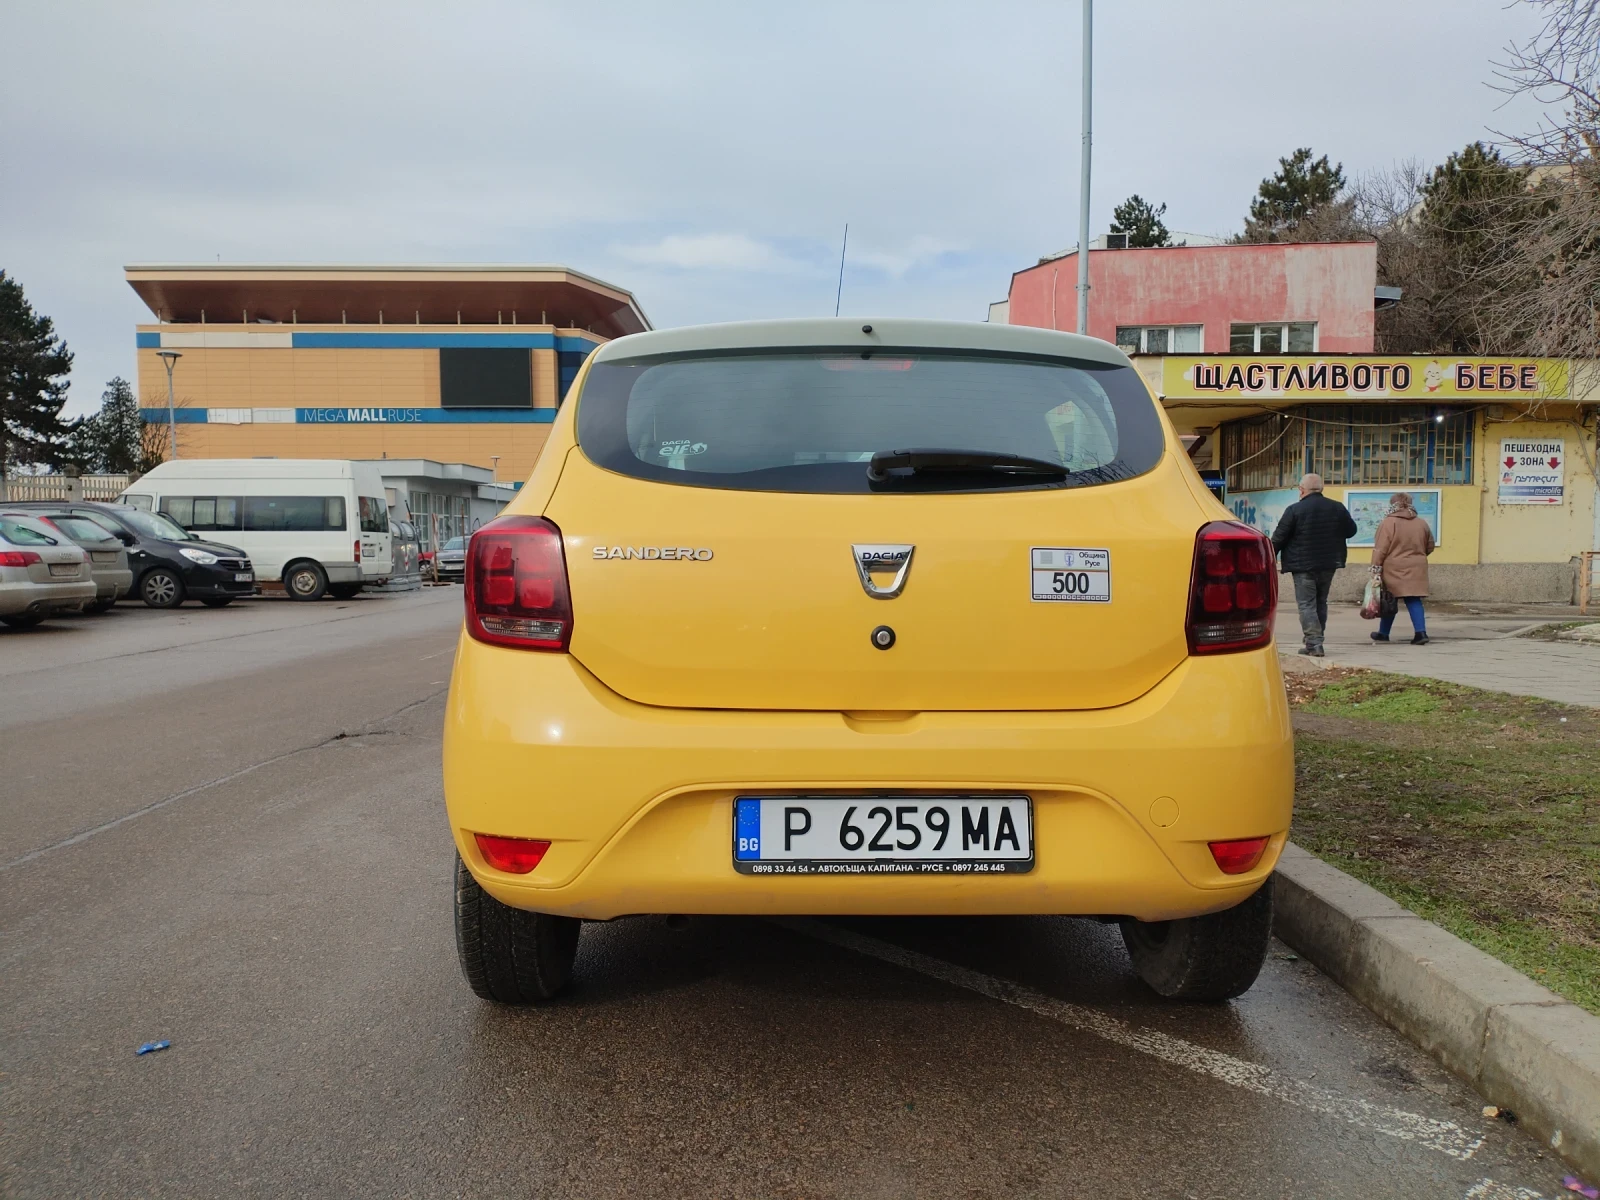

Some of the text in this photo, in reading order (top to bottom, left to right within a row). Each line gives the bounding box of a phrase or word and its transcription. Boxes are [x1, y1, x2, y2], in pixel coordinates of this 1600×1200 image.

[1194, 363, 1538, 391] ЩАСТЛИВОТО БЕБЕ
[304, 408, 423, 422] MEGA MALL RUSE
[658, 444, 691, 456] elf
[1504, 443, 1562, 454] ПЕШЕХОДНА
[1519, 456, 1545, 466] ЗОНА
[1534, 486, 1562, 494] microlife
[592, 546, 714, 561] SANDERO
[862, 552, 904, 560] DACIA
[1078, 551, 1106, 560] Община
[1084, 560, 1101, 568] Русе
[1052, 572, 1090, 594] 500
[784, 807, 812, 851] P
[839, 806, 950, 851] 6259
[739, 837, 759, 851] BG
[752, 863, 1006, 873] 0898 33 44 54 АВТОКЪЩА КАПИТАНА РУСЕ 0897 245 445
